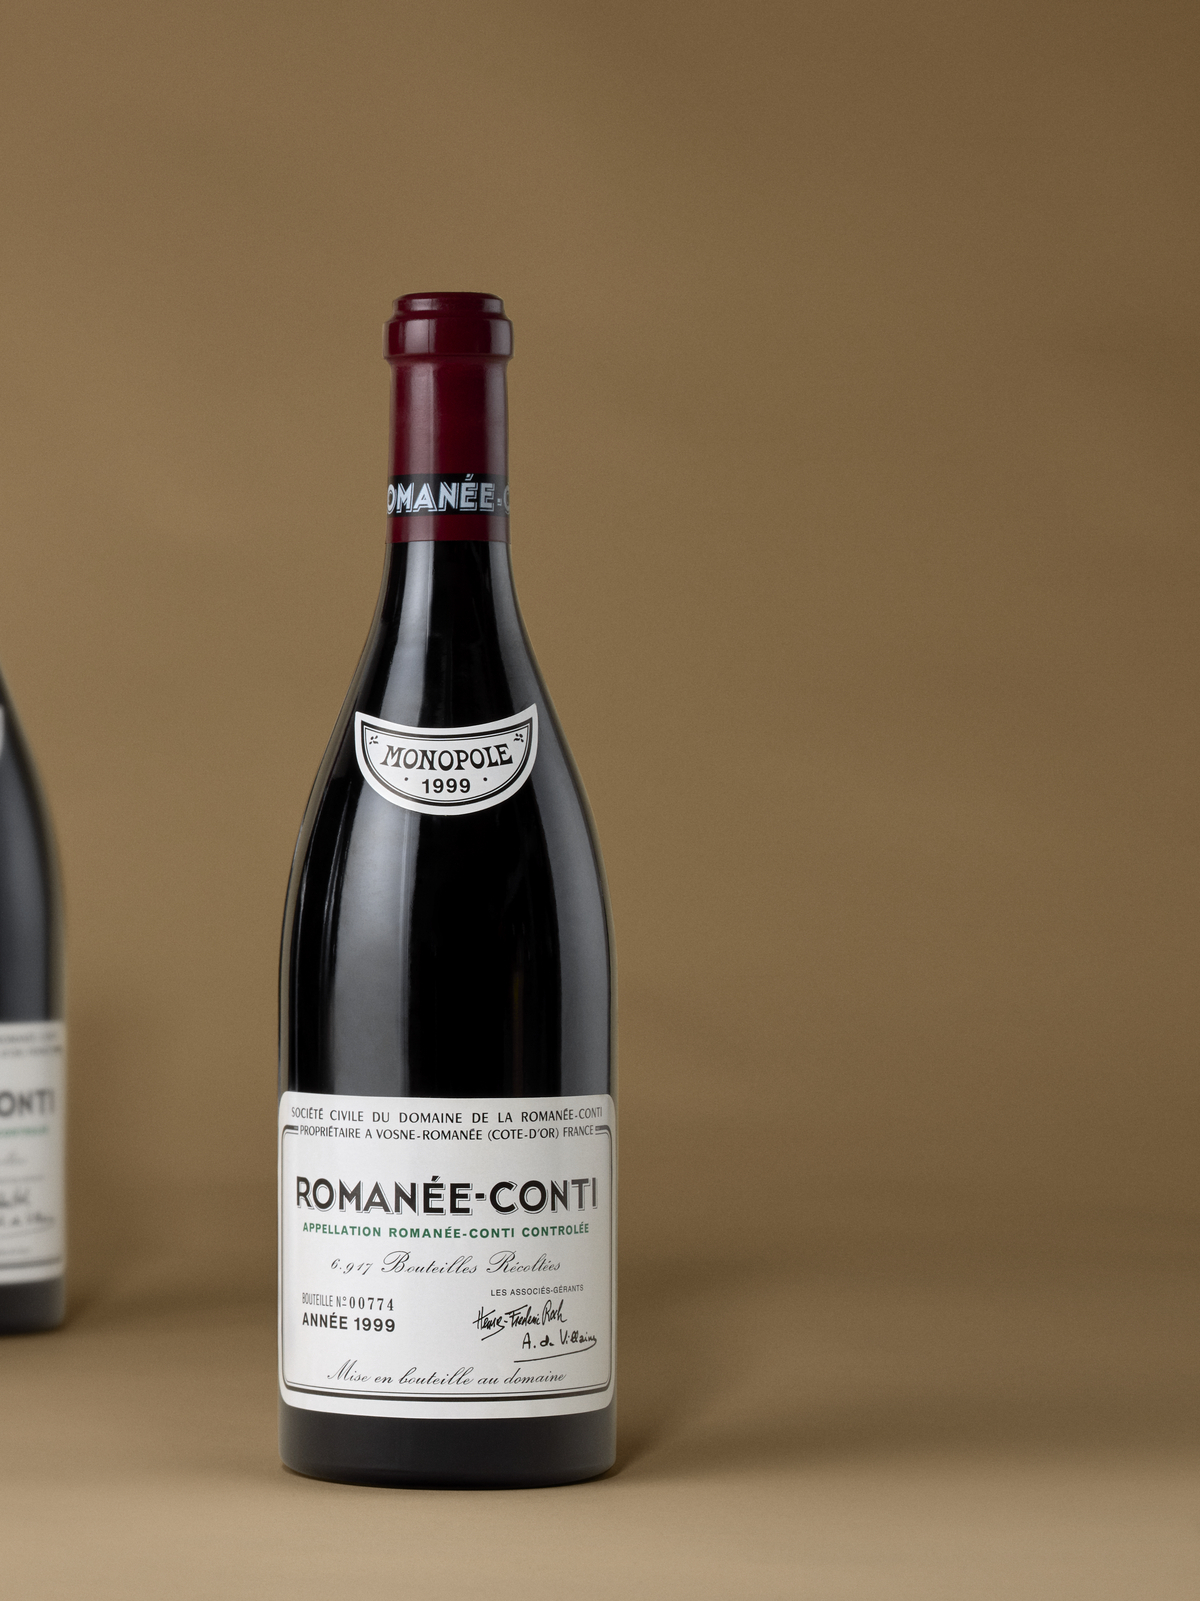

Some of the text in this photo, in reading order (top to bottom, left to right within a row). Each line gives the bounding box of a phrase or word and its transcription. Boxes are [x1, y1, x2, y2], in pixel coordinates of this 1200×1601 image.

[379, 743, 513, 771] MONOPOLE
[422, 778, 470, 793] 1999
[292, 1107, 602, 1123] SOCIÉTÉ CIVILE DU DOMAINE DE LA ROMANÉE-CONTI
[300, 1124, 362, 1139] PROPRIÉTAIRE
[365, 1129, 372, 1138] A
[376, 1128, 482, 1140] VOSNE-ROMANÉE
[562, 1125, 595, 1138] FRANCE
[297, 1176, 598, 1215] ROMANÉE-CONTI
[303, 1222, 589, 1238] APPELLATION ROMANÉE-CONTI CONTROLÉE
[381, 1251, 477, 1273] Bouteilles
[486, 1251, 560, 1273] Récoltées
[510, 1284, 583, 1295] ASSOCIÉS-GÉRANTS
[302, 1292, 333, 1307] BOUTEILLE
[303, 1312, 395, 1332] ANNÉE 1999
[327, 1359, 568, 1386] Mise en bouteille au domaine
